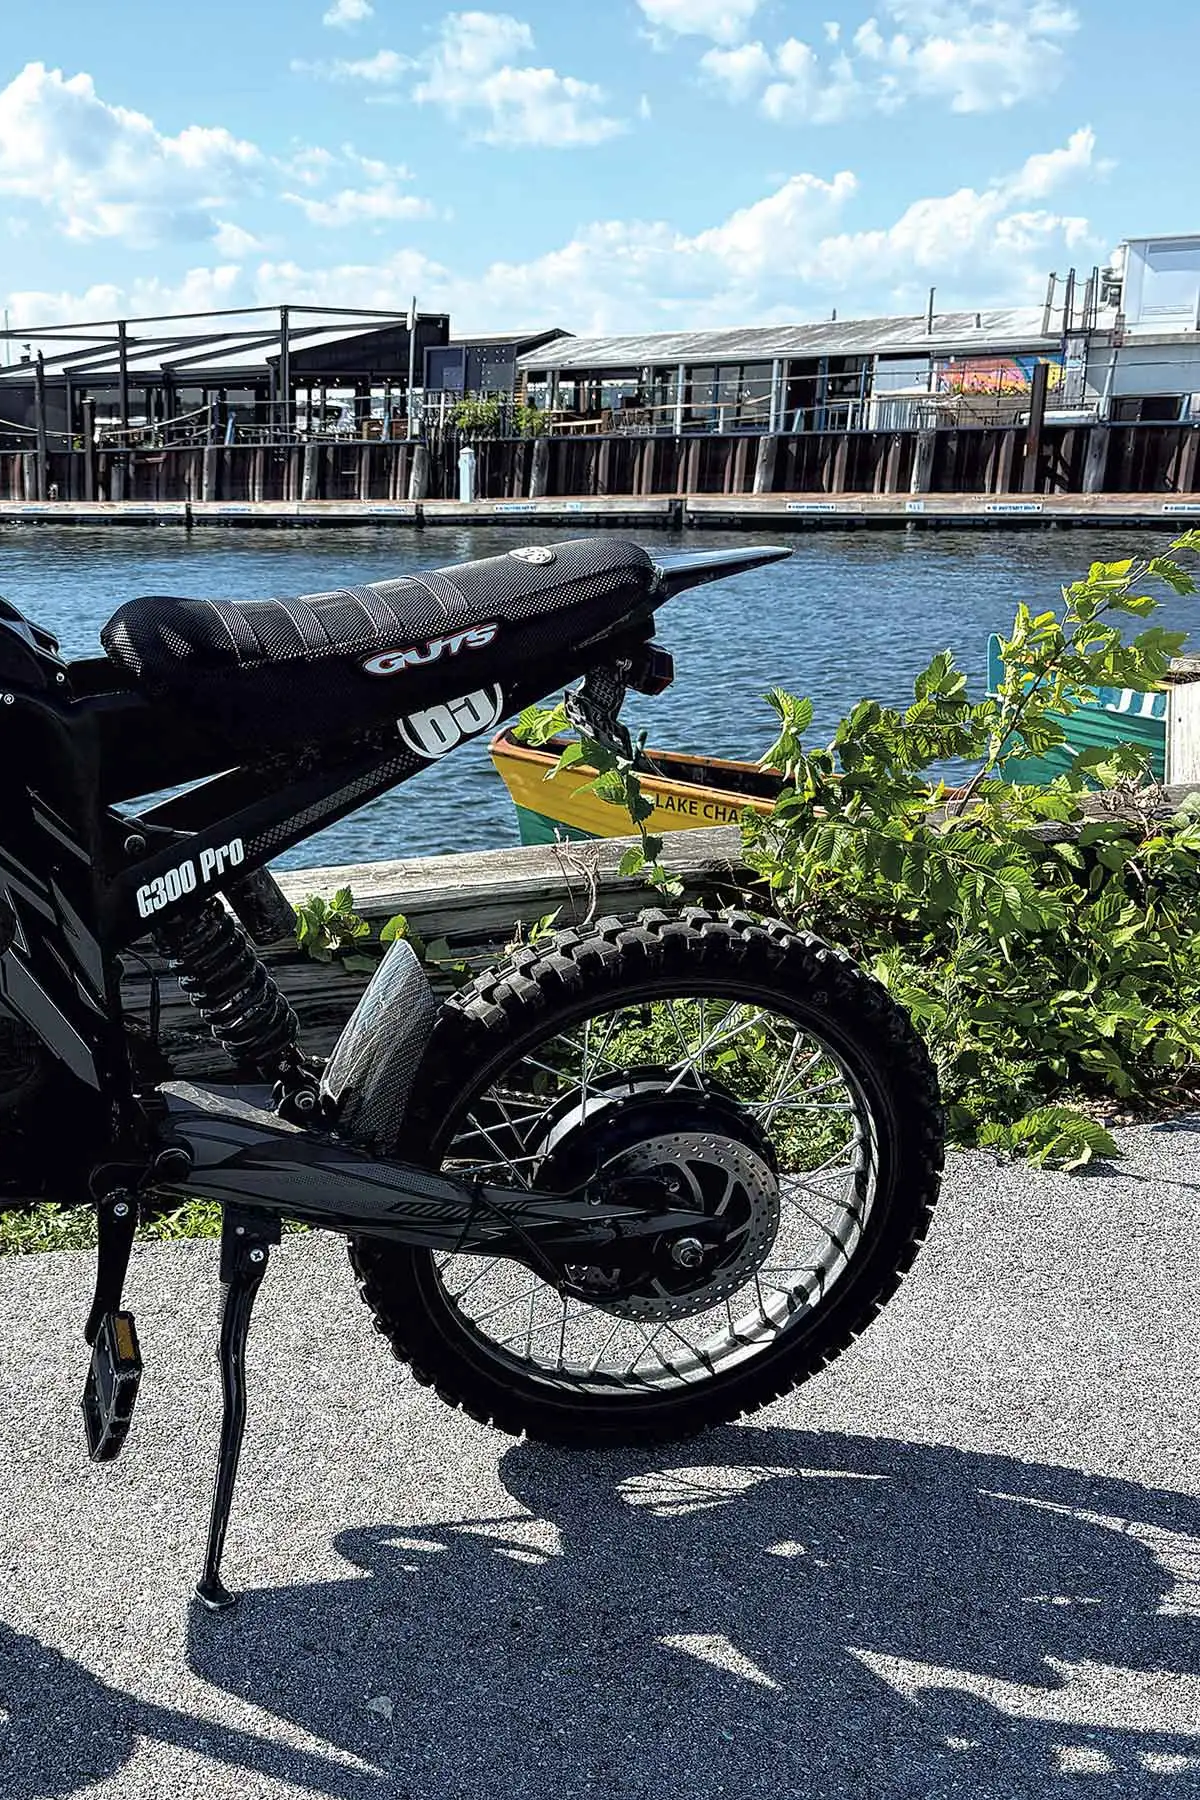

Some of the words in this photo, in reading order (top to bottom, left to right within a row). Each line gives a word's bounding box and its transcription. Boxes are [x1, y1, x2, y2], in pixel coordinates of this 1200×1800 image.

[362, 621, 499, 675] GUTS
[654, 793, 697, 816] LAKE
[703, 804, 739, 823] CHA
[135, 859, 197, 919] G300
[199, 837, 245, 884] Pro
